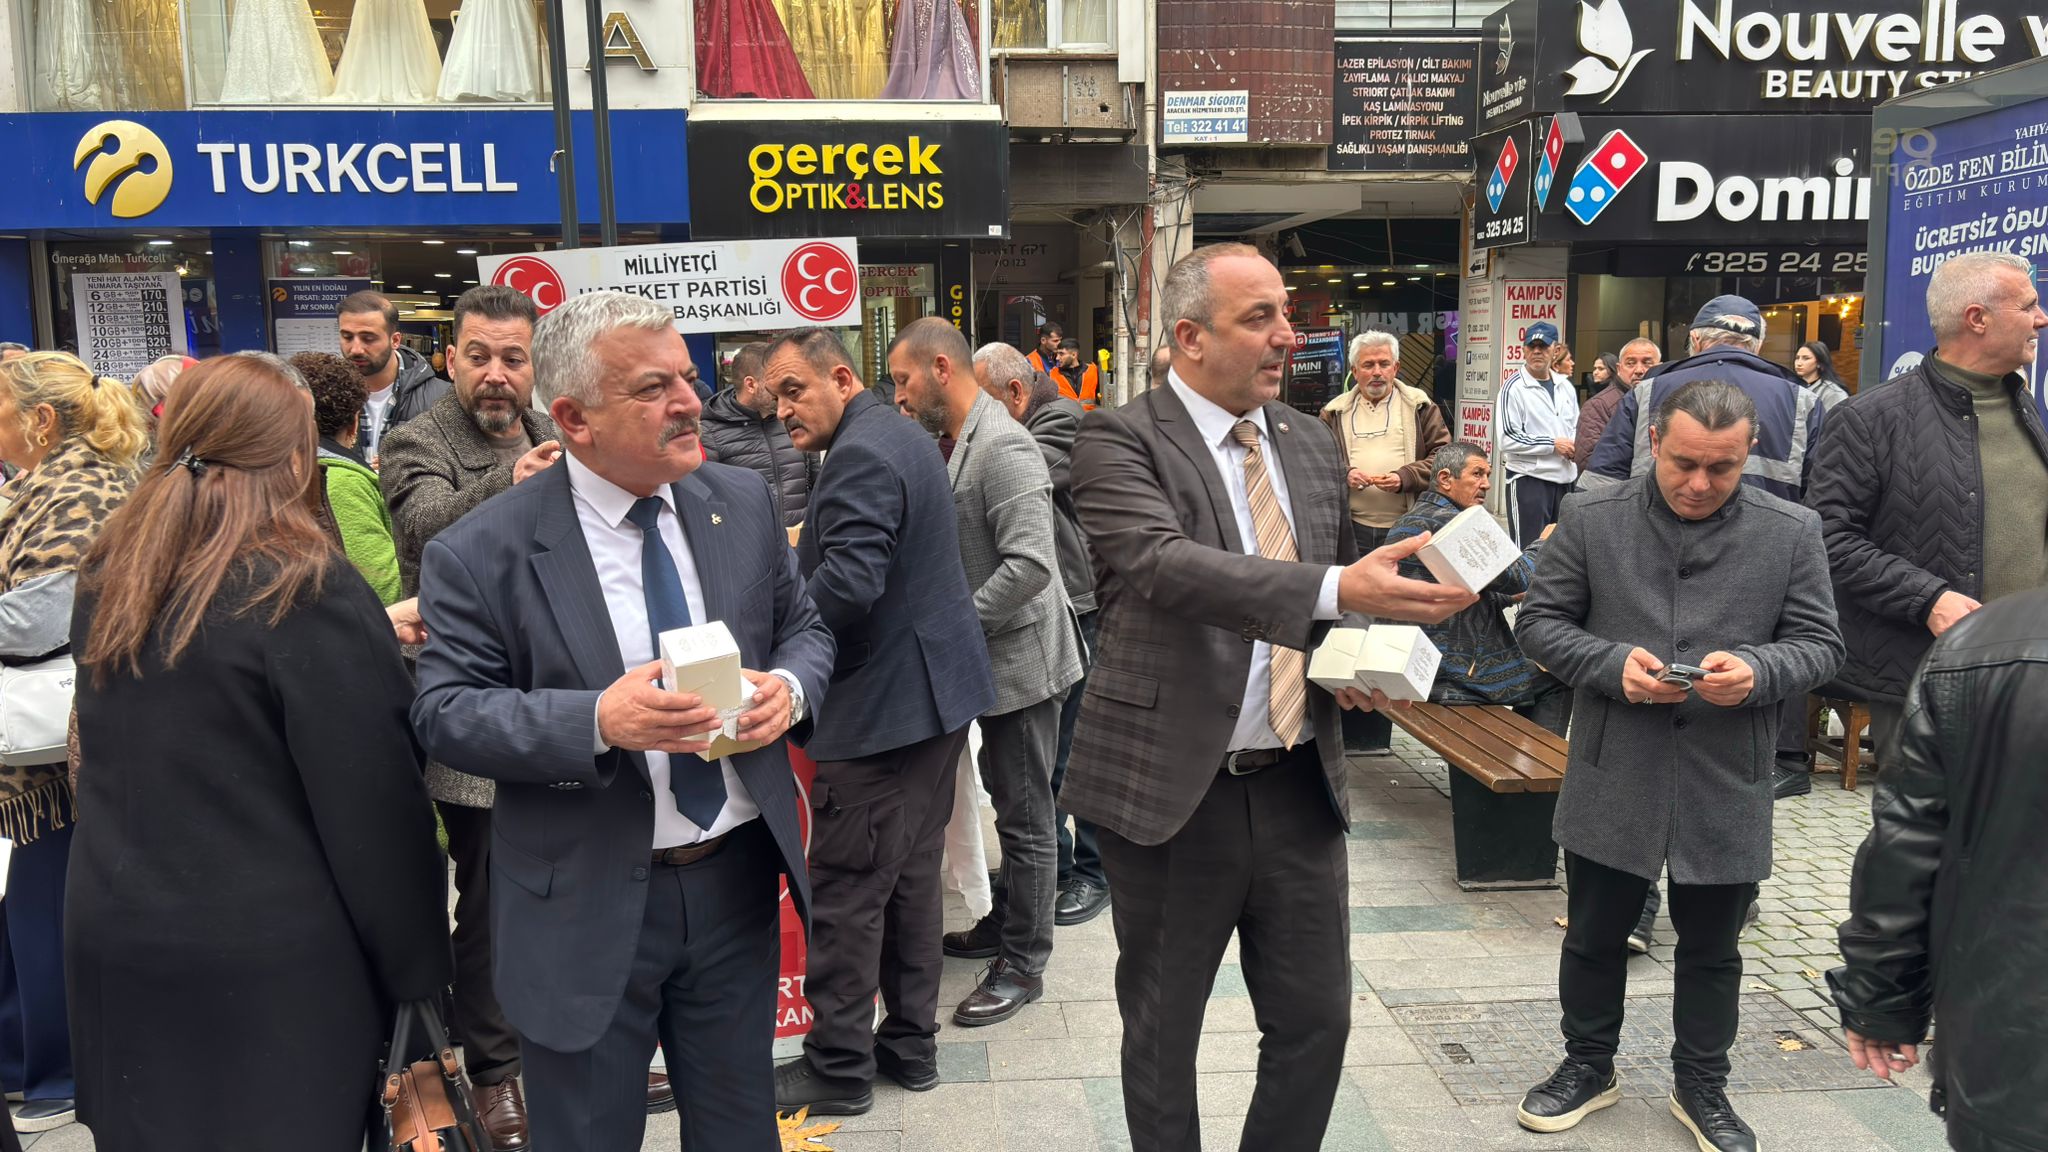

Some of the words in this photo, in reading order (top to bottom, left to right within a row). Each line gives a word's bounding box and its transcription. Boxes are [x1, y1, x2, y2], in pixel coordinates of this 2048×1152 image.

[1677, 0, 2006, 62] Nouvelle
[1338, 58, 1364, 68] LAZER
[1368, 56, 1414, 68] EPİLASYON
[1422, 56, 1440, 68] CİLT
[1442, 59, 1472, 68] BAKIMI
[1343, 73, 1390, 83] ZAYIFLAMA
[1401, 73, 1428, 83] KALICI
[1430, 73, 1464, 83] MAKYAJ
[1763, 69, 1909, 99] BEAUTY
[1167, 96, 1206, 107] DENMAR
[1208, 94, 1246, 106] SİGORTA
[1352, 88, 1388, 97] STRIORT
[1390, 88, 1422, 100] ÇATLAK
[1425, 88, 1456, 98] BAKIMI
[1364, 102, 1380, 113] KAŞ
[1382, 100, 1444, 112] LAMİNASYONU
[1166, 120, 1188, 132] Tel:
[1191, 120, 1212, 132] 322
[1215, 120, 1228, 132] 41
[1232, 120, 1246, 132] 41
[1342, 113, 1362, 126] İPEK
[1364, 113, 1392, 126] KİRPİK
[1400, 113, 1430, 126] KİRPİK
[1431, 113, 1464, 126] LİFTİNG
[1370, 130, 1402, 140] PROTEZ
[1404, 130, 1436, 140] TIRNAK
[1336, 142, 1374, 154] SAĞLIKLI
[1376, 144, 1405, 156] YAŞAM
[1408, 142, 1468, 156] DANIŞMANLIĞI
[748, 136, 944, 180] gerçek
[197, 142, 518, 193] TURKCELL
[1904, 164, 1954, 192] ÖZDE
[1958, 154, 1996, 181] FEN
[1904, 189, 1966, 211] EĞİTİM
[1486, 220, 1500, 238] 325
[1502, 218, 1512, 236] 24
[1512, 216, 1524, 234] 25
[1914, 212, 1998, 252] ÜCRETSİZ
[52, 253, 96, 266] Ömerağa
[98, 254, 124, 264] Mah.
[126, 253, 166, 264] Turkcell
[624, 250, 718, 276] MİLLİYETÇİ
[1703, 252, 1768, 272] 325
[1778, 252, 1822, 272] 24
[1831, 252, 1868, 272] 25
[124, 282, 162, 290] TAŞIYANA
[292, 284, 310, 292] YILIN
[312, 284, 320, 292] EN
[687, 274, 767, 298] PARTİSİ
[1507, 282, 1562, 300] KAMPÜS
[673, 298, 781, 322] BAŞKANLIĞI
[1512, 304, 1556, 319] EMLAK
[1297, 360, 1322, 372] MINI
[1462, 404, 1490, 422] KAMPÜS
[1464, 424, 1487, 438] EMLAK
